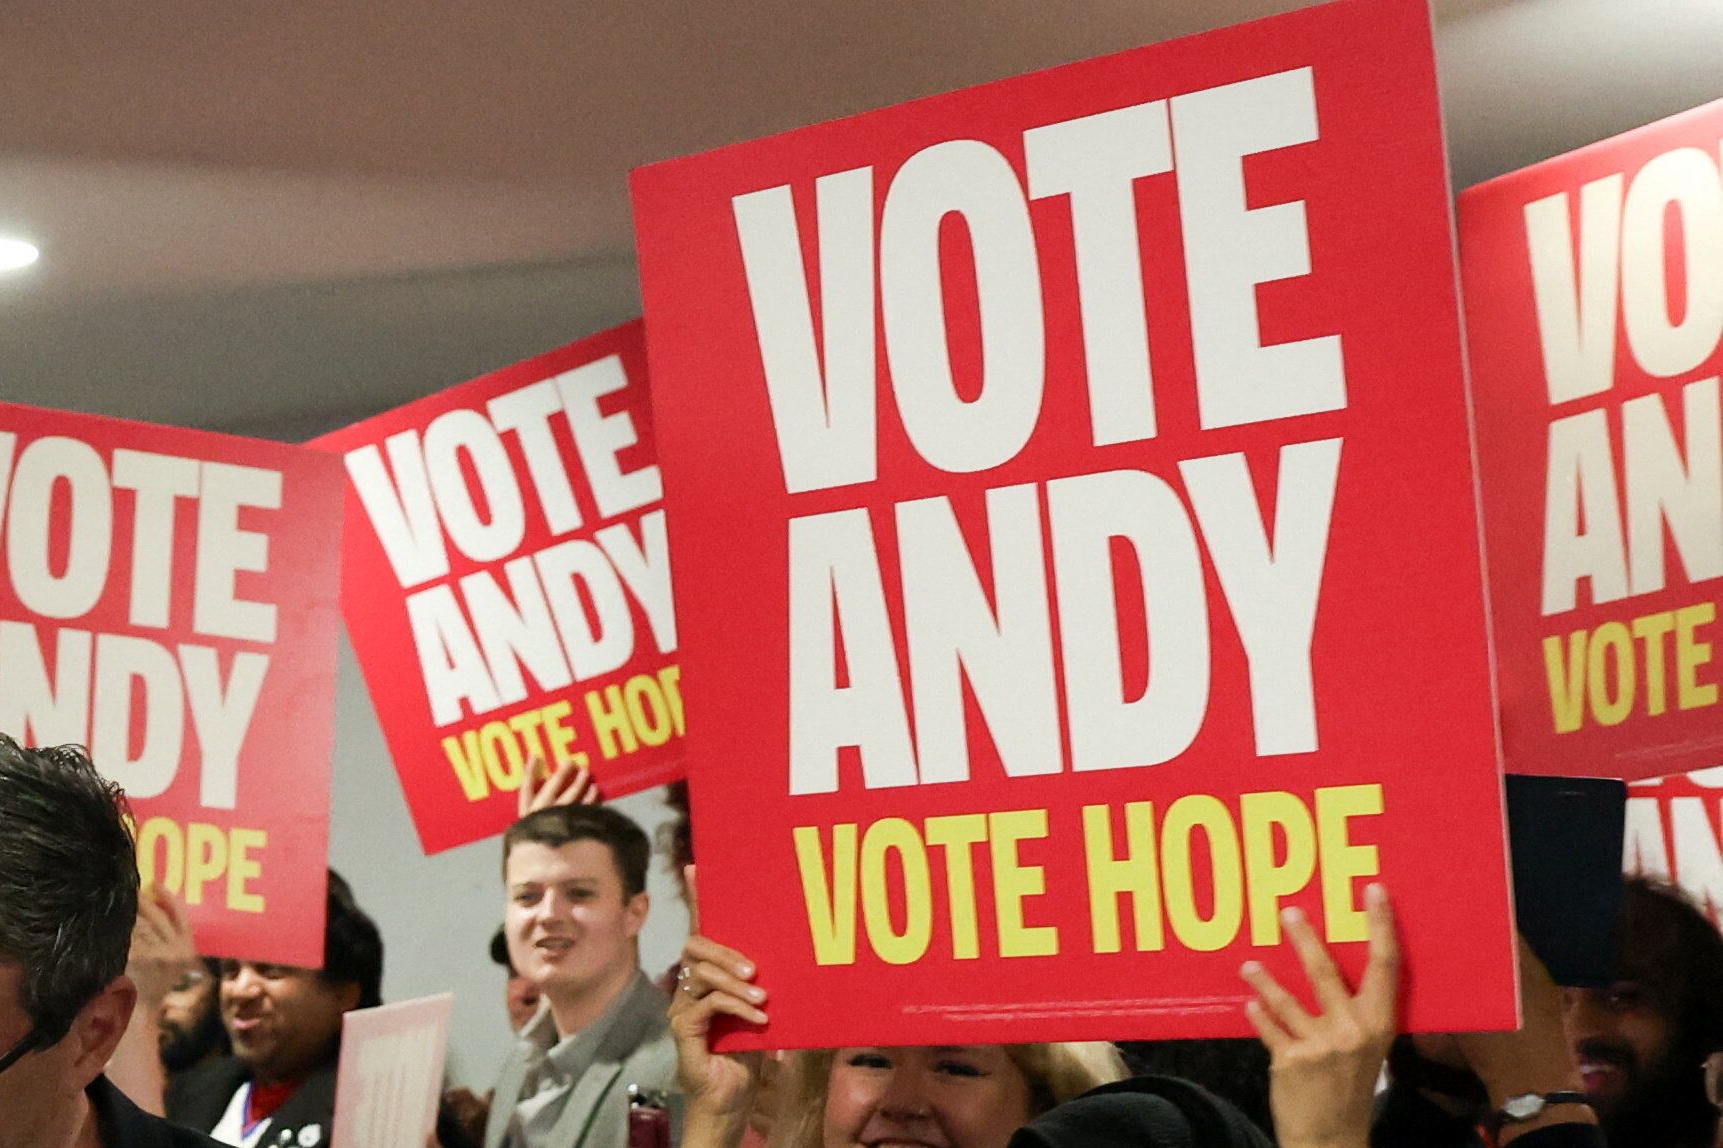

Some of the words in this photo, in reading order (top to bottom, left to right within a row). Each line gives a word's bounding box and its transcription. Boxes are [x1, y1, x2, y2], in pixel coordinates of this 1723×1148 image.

[731, 65, 1348, 496] VOTE
[1524, 139, 1723, 405] VO
[344, 353, 664, 589] VOTE
[1540, 376, 1723, 615] AN
[405, 508, 678, 728] ANDY
[787, 436, 1344, 797] ANDY
[1542, 602, 1719, 735] VOTE
[441, 700, 590, 801] VOTE
[583, 664, 687, 761] HOP
[121, 812, 269, 914] OPE
[792, 808, 1059, 967] VOTE
[1082, 783, 1385, 956] HOPE
